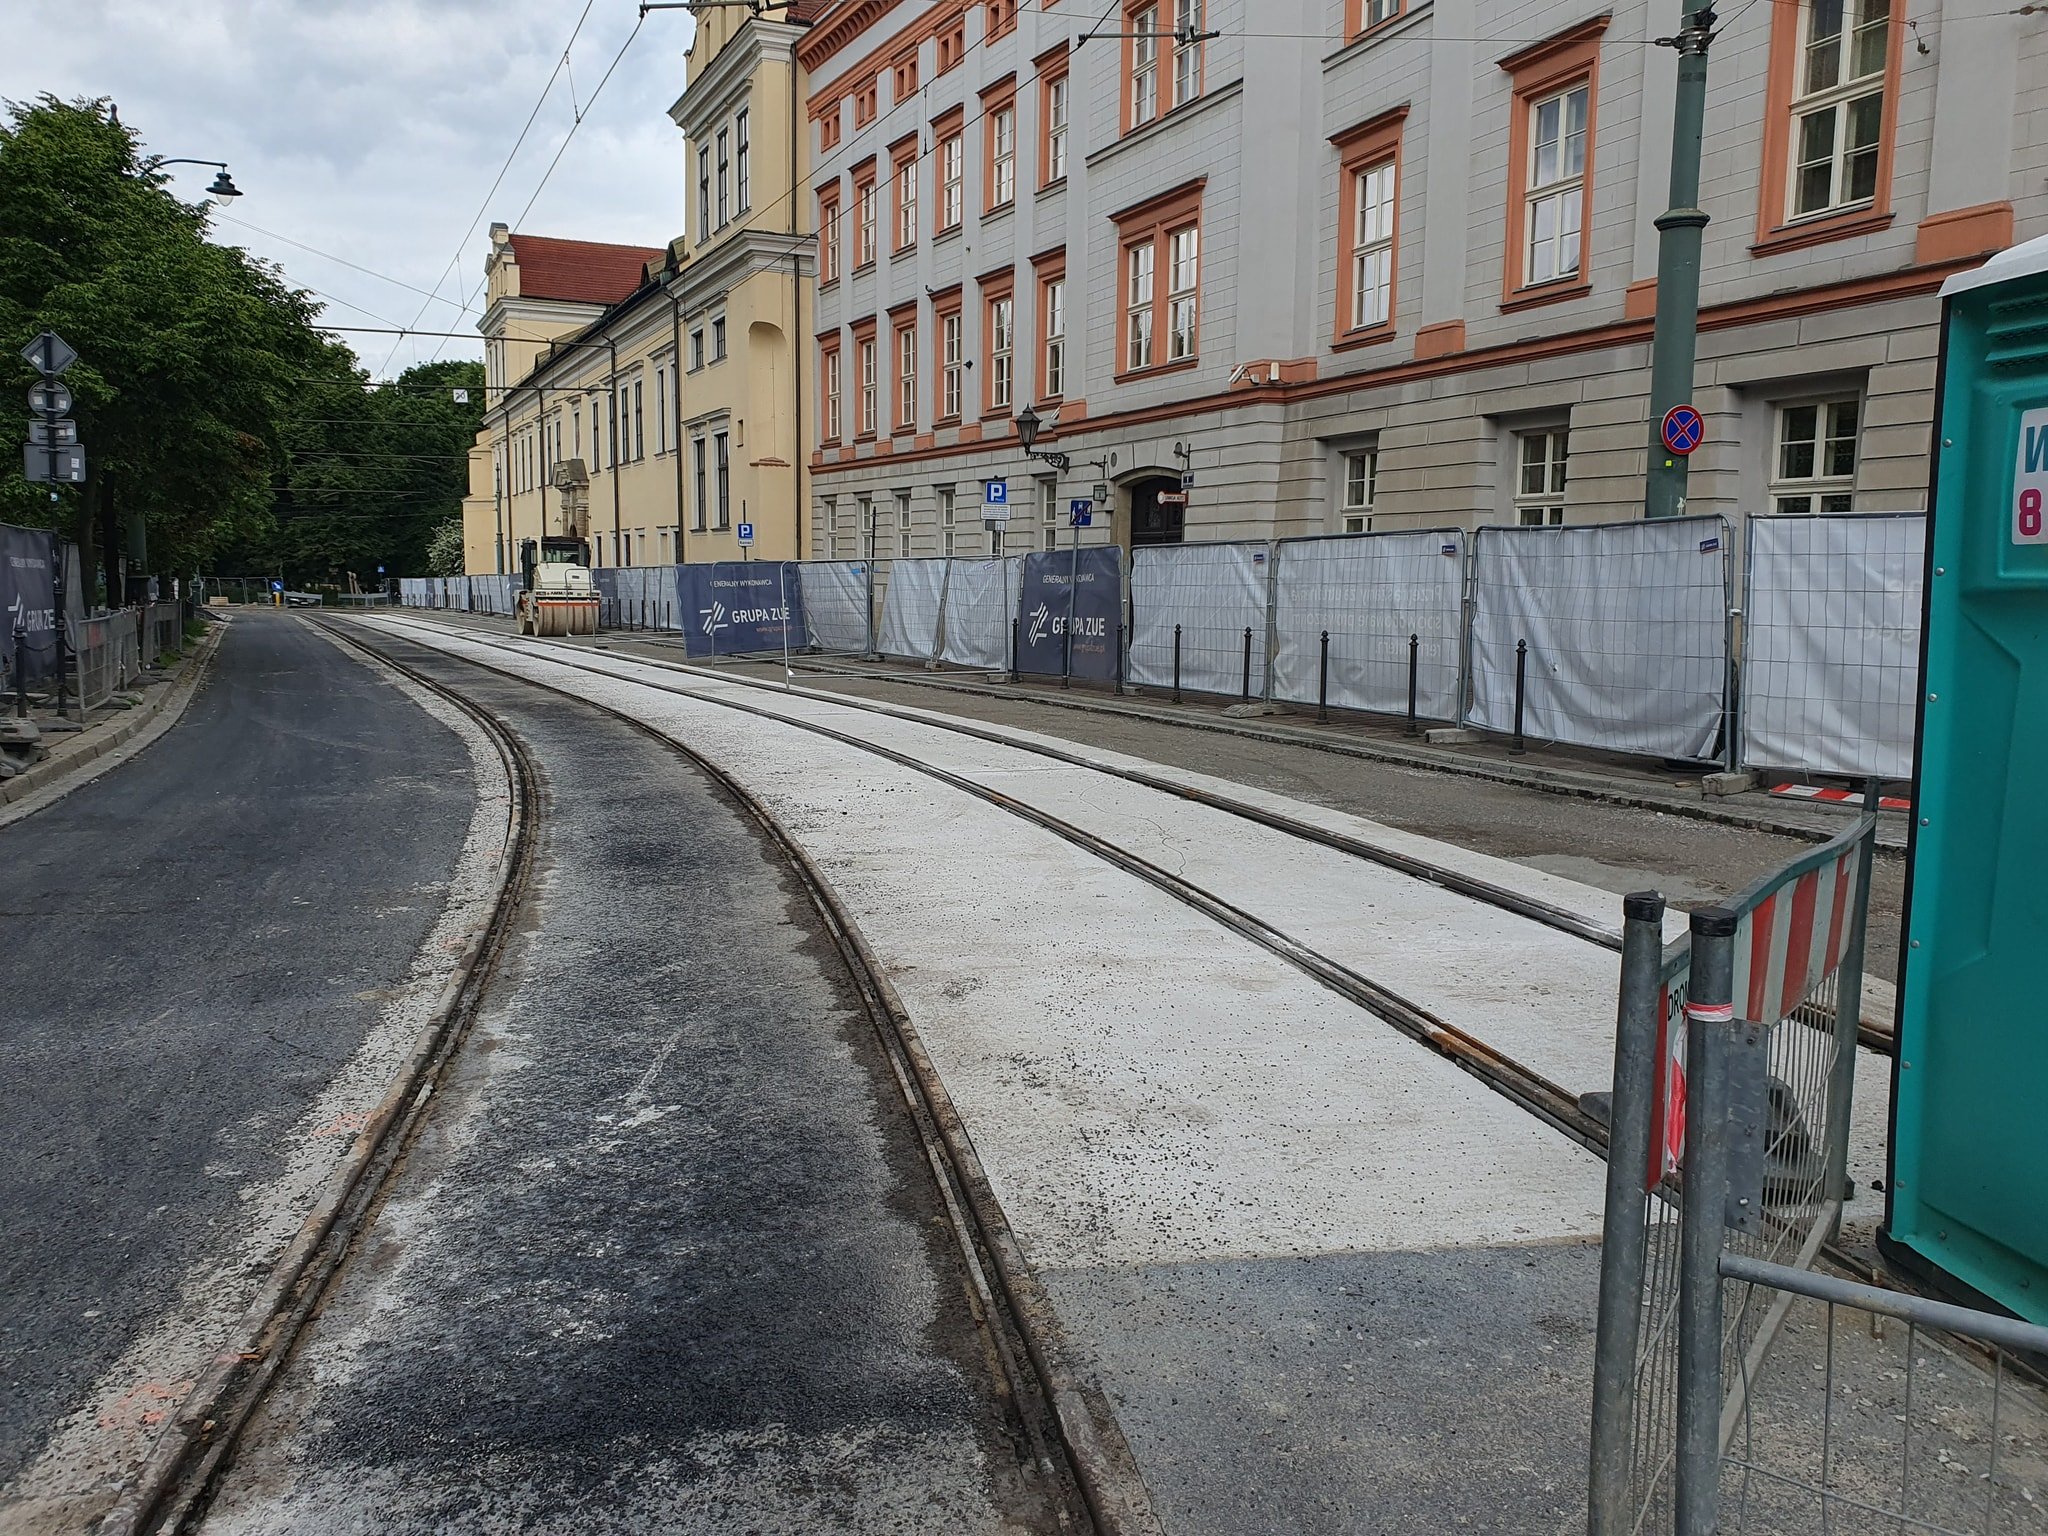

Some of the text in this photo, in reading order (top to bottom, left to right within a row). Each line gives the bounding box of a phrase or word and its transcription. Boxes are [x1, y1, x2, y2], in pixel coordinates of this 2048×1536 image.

[990, 484, 1003, 502] P
[740, 525, 750, 537] P
[731, 607, 791, 624] GRUPA ZUE
[1085, 617, 1105, 637] ZUE
